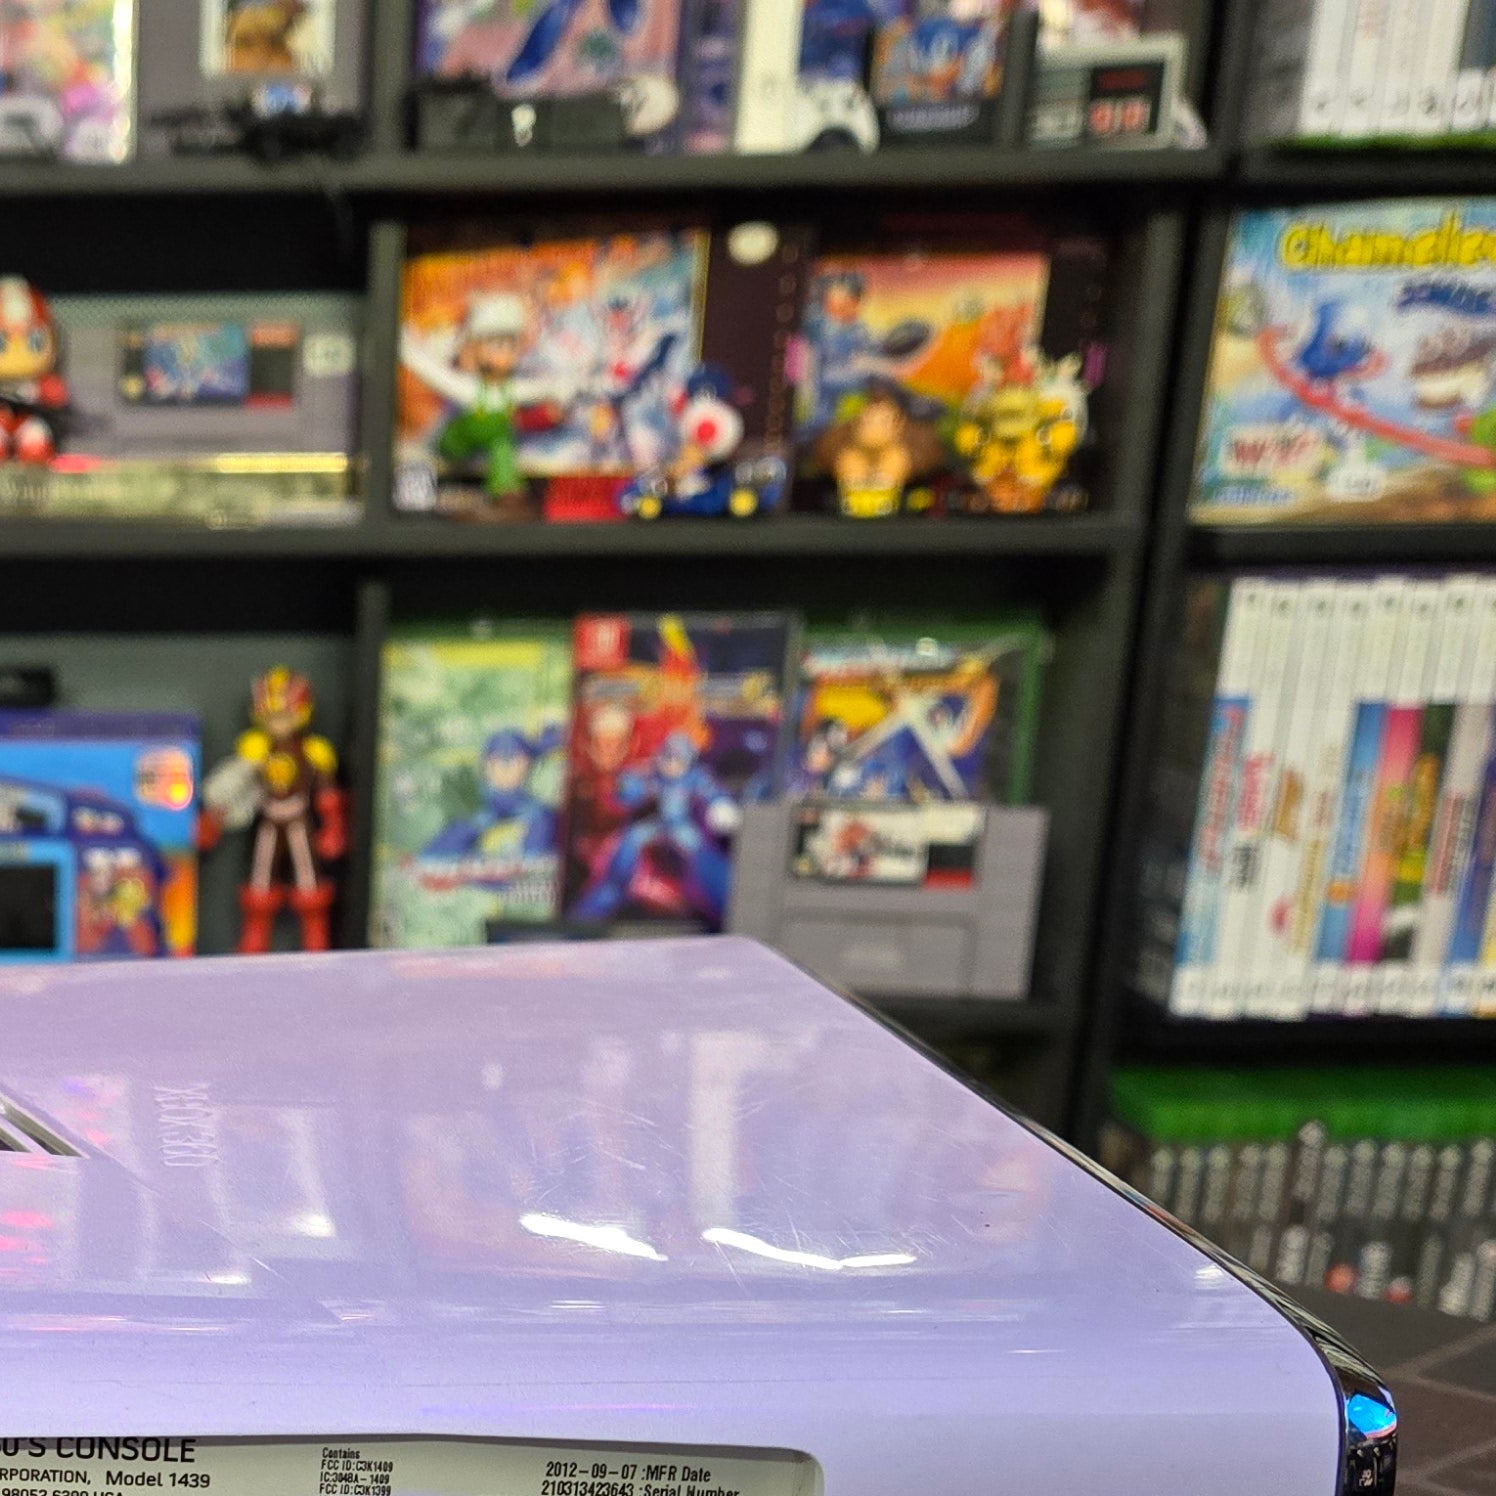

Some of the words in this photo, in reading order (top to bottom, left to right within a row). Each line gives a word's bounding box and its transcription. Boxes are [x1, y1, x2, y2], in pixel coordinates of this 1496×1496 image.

[56, 1437, 197, 1462] CONSOLE
[320, 1459, 340, 1470] FCC
[105, 1470, 164, 1488] Model
[168, 1472, 211, 1489] 1439
[681, 1466, 711, 1483] Date
[319, 1483, 339, 1495] FCC
